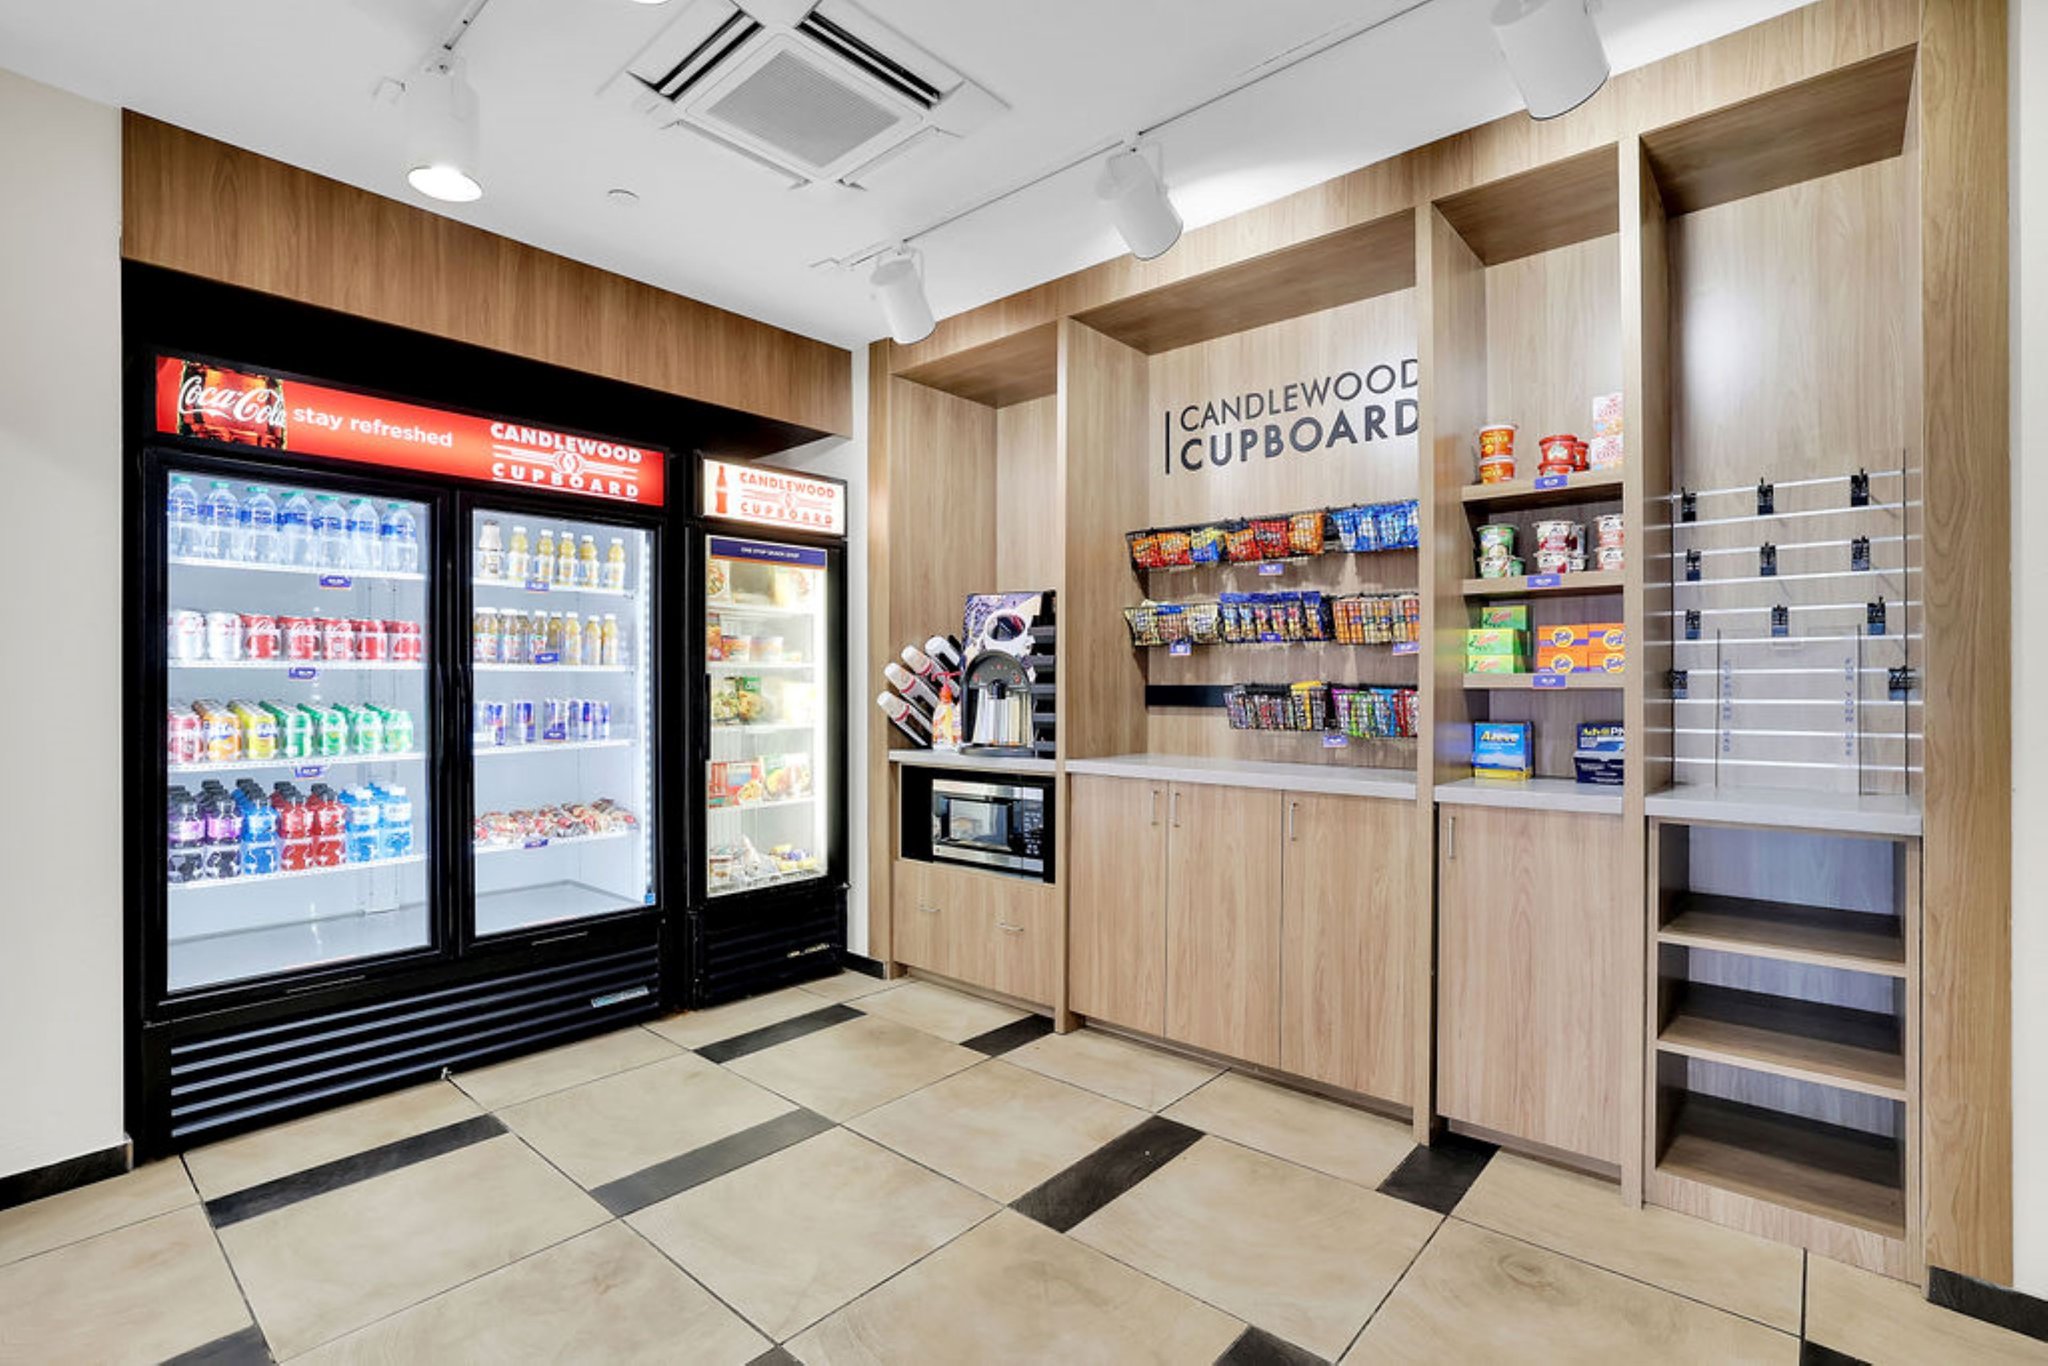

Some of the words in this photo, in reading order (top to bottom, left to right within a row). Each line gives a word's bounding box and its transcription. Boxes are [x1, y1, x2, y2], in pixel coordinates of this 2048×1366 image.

[180, 375, 286, 427] Coca-Cola
[1180, 358, 1418, 432] CANDLEWOOD
[293, 407, 343, 430] stay
[350, 418, 453, 448] refreshed
[490, 423, 642, 463] CANDLEWOOD
[1180, 399, 1418, 471] CUPBOARD
[492, 463, 639, 498] CUPBOARD
[739, 472, 836, 499] CANDLEWOOD
[741, 502, 834, 525] CUPBOARD
